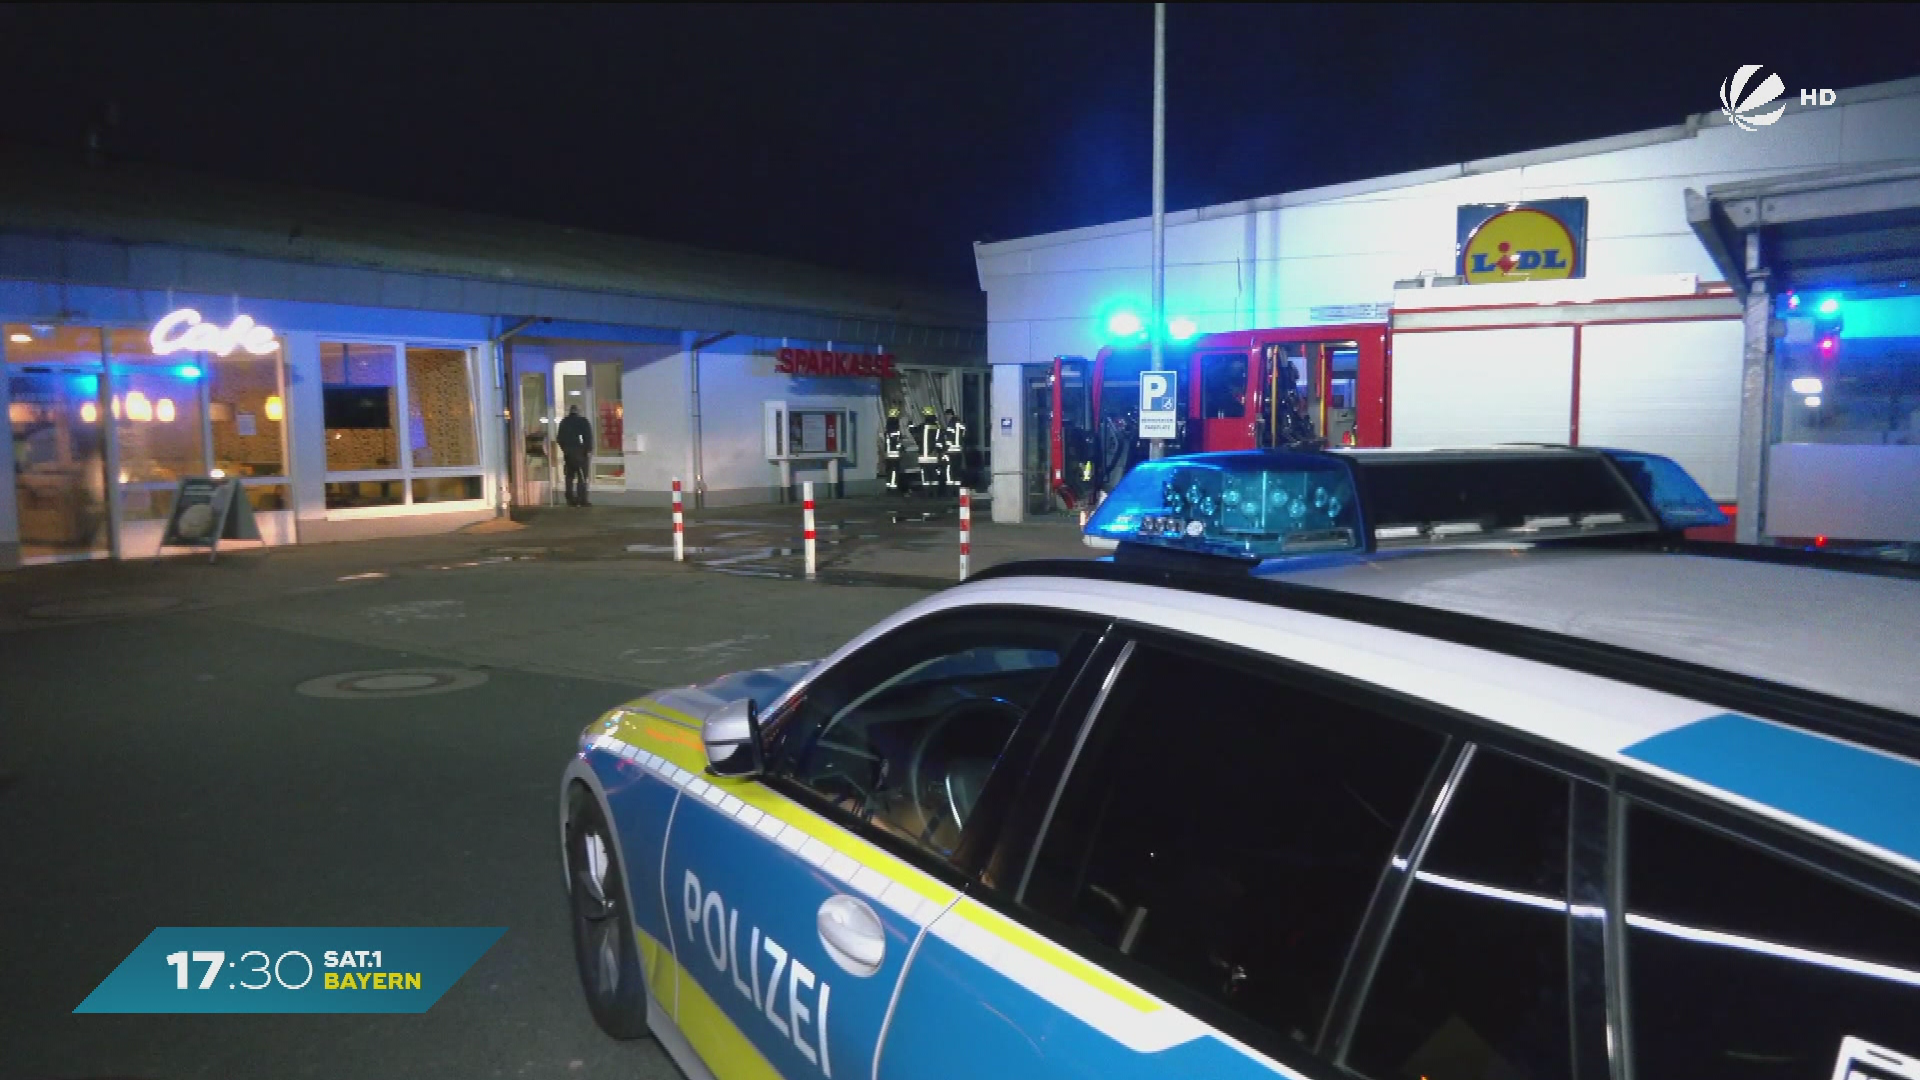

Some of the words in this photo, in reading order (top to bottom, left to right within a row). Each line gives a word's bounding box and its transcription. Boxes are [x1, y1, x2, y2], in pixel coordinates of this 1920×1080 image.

[775, 347, 896, 378] SPARKASSE
[1142, 374, 1167, 410] P
[684, 869, 831, 1079] POLIZEI
